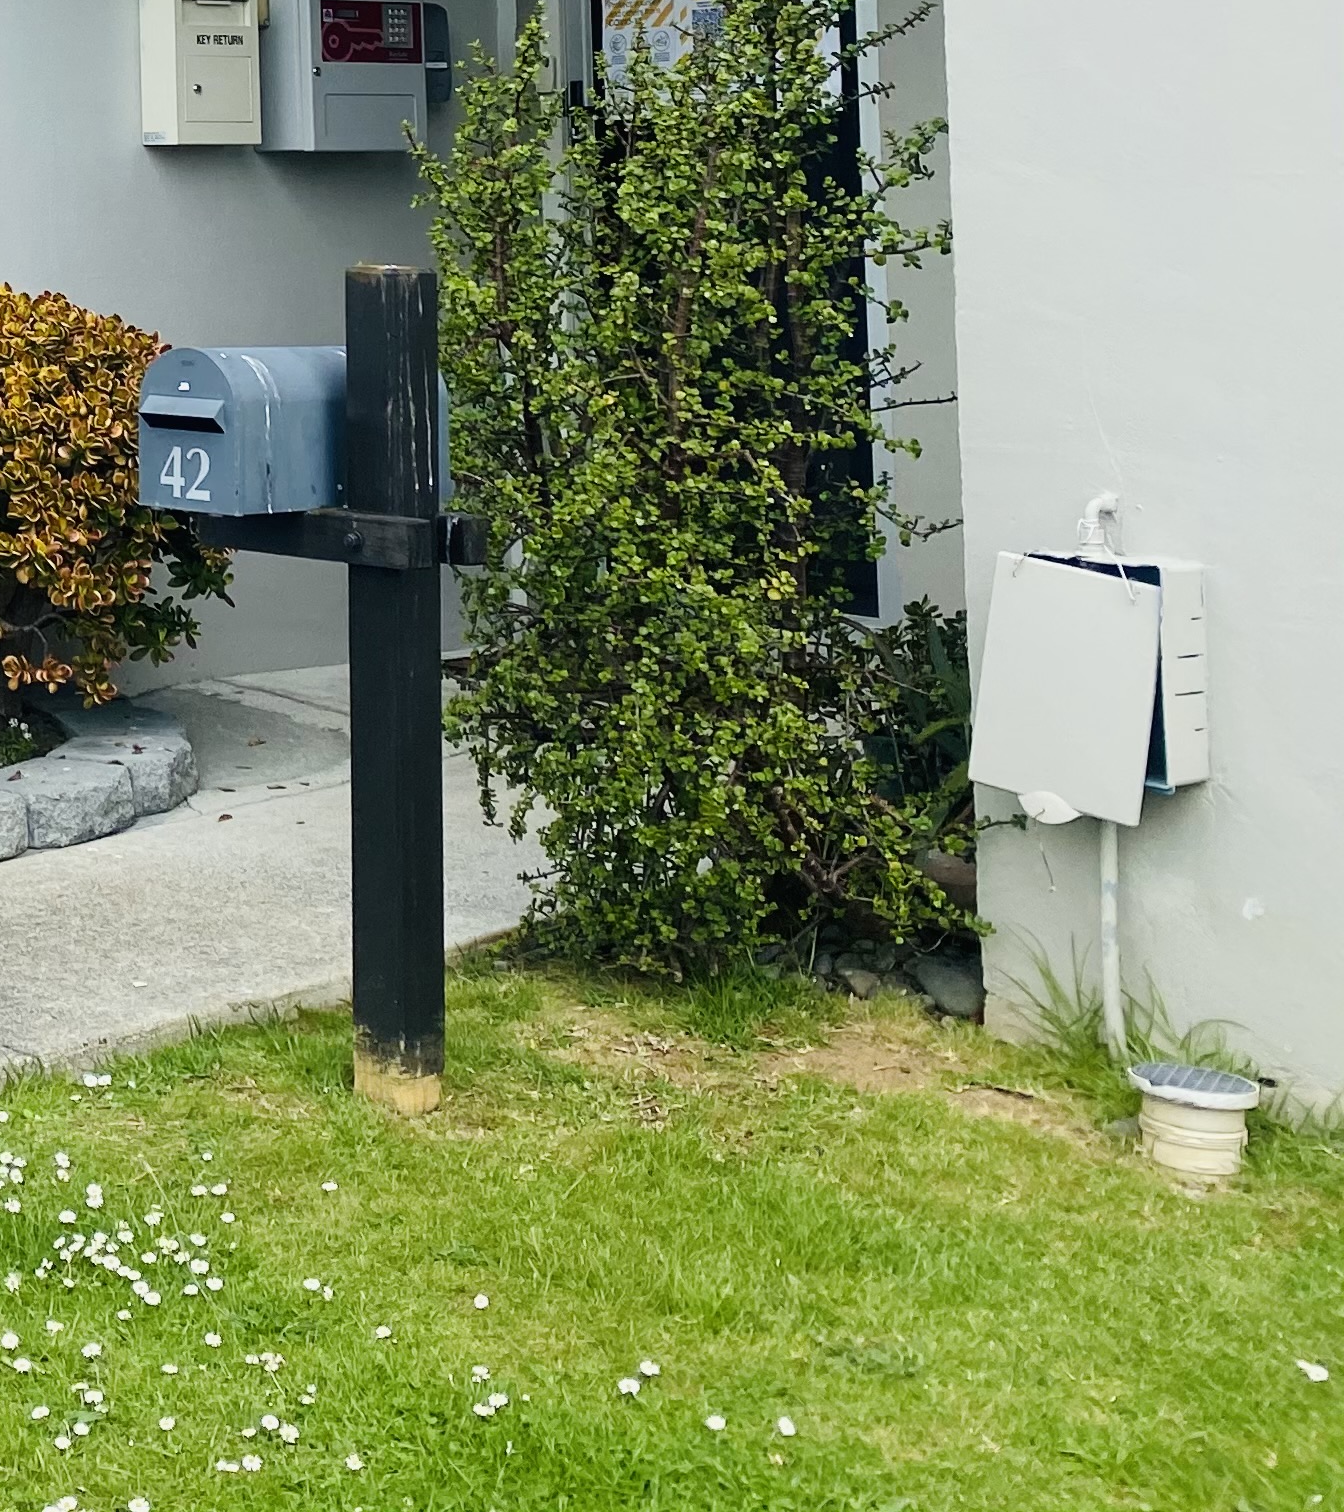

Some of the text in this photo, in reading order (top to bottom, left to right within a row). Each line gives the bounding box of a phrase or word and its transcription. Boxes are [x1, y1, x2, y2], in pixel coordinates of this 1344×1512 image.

[196, 34, 244, 45] KEY RETURN
[160, 446, 211, 502] 42
